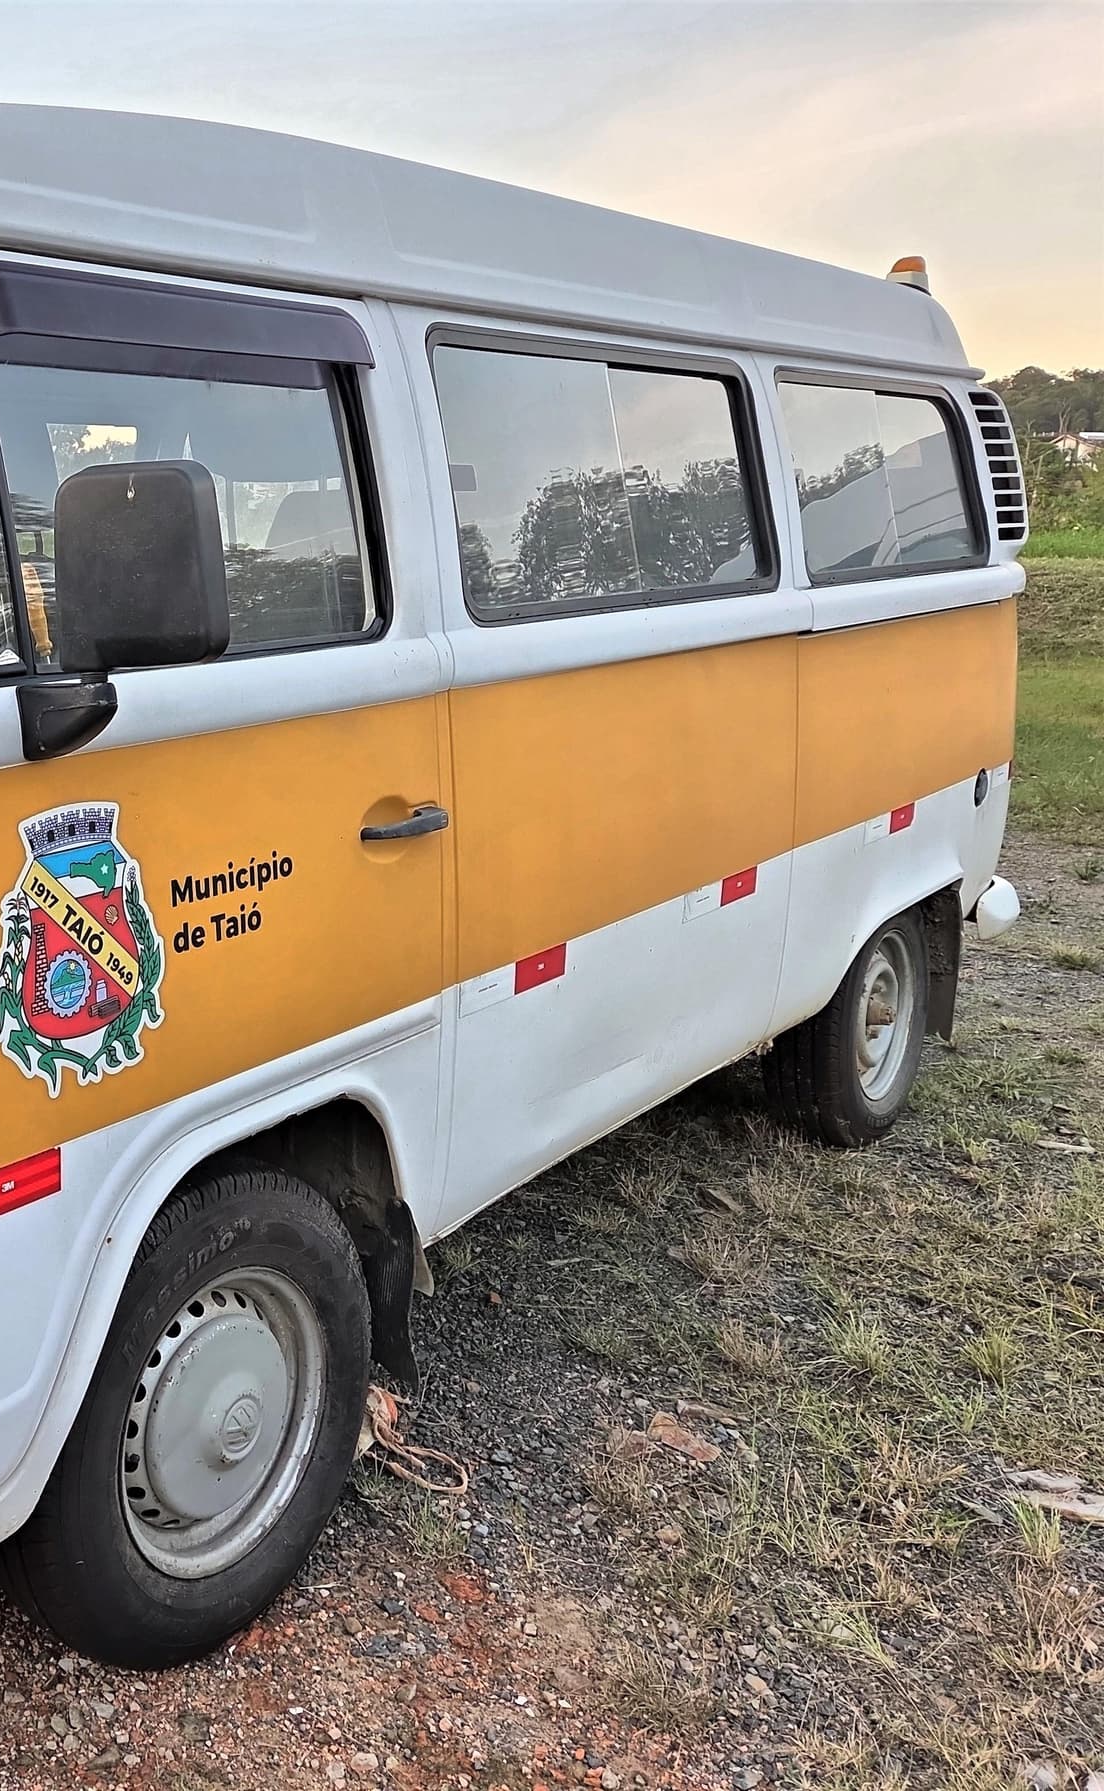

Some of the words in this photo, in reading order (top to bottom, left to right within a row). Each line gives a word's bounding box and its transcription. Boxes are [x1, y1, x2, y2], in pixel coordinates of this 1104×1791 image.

[170, 850, 294, 907] Município
[29, 876, 59, 909] 1917
[60, 904, 106, 956] TAIÓ
[106, 952, 134, 986] 1949
[172, 921, 205, 953] de
[210, 902, 262, 943] Taió
[1, 1180, 15, 1193] 3M
